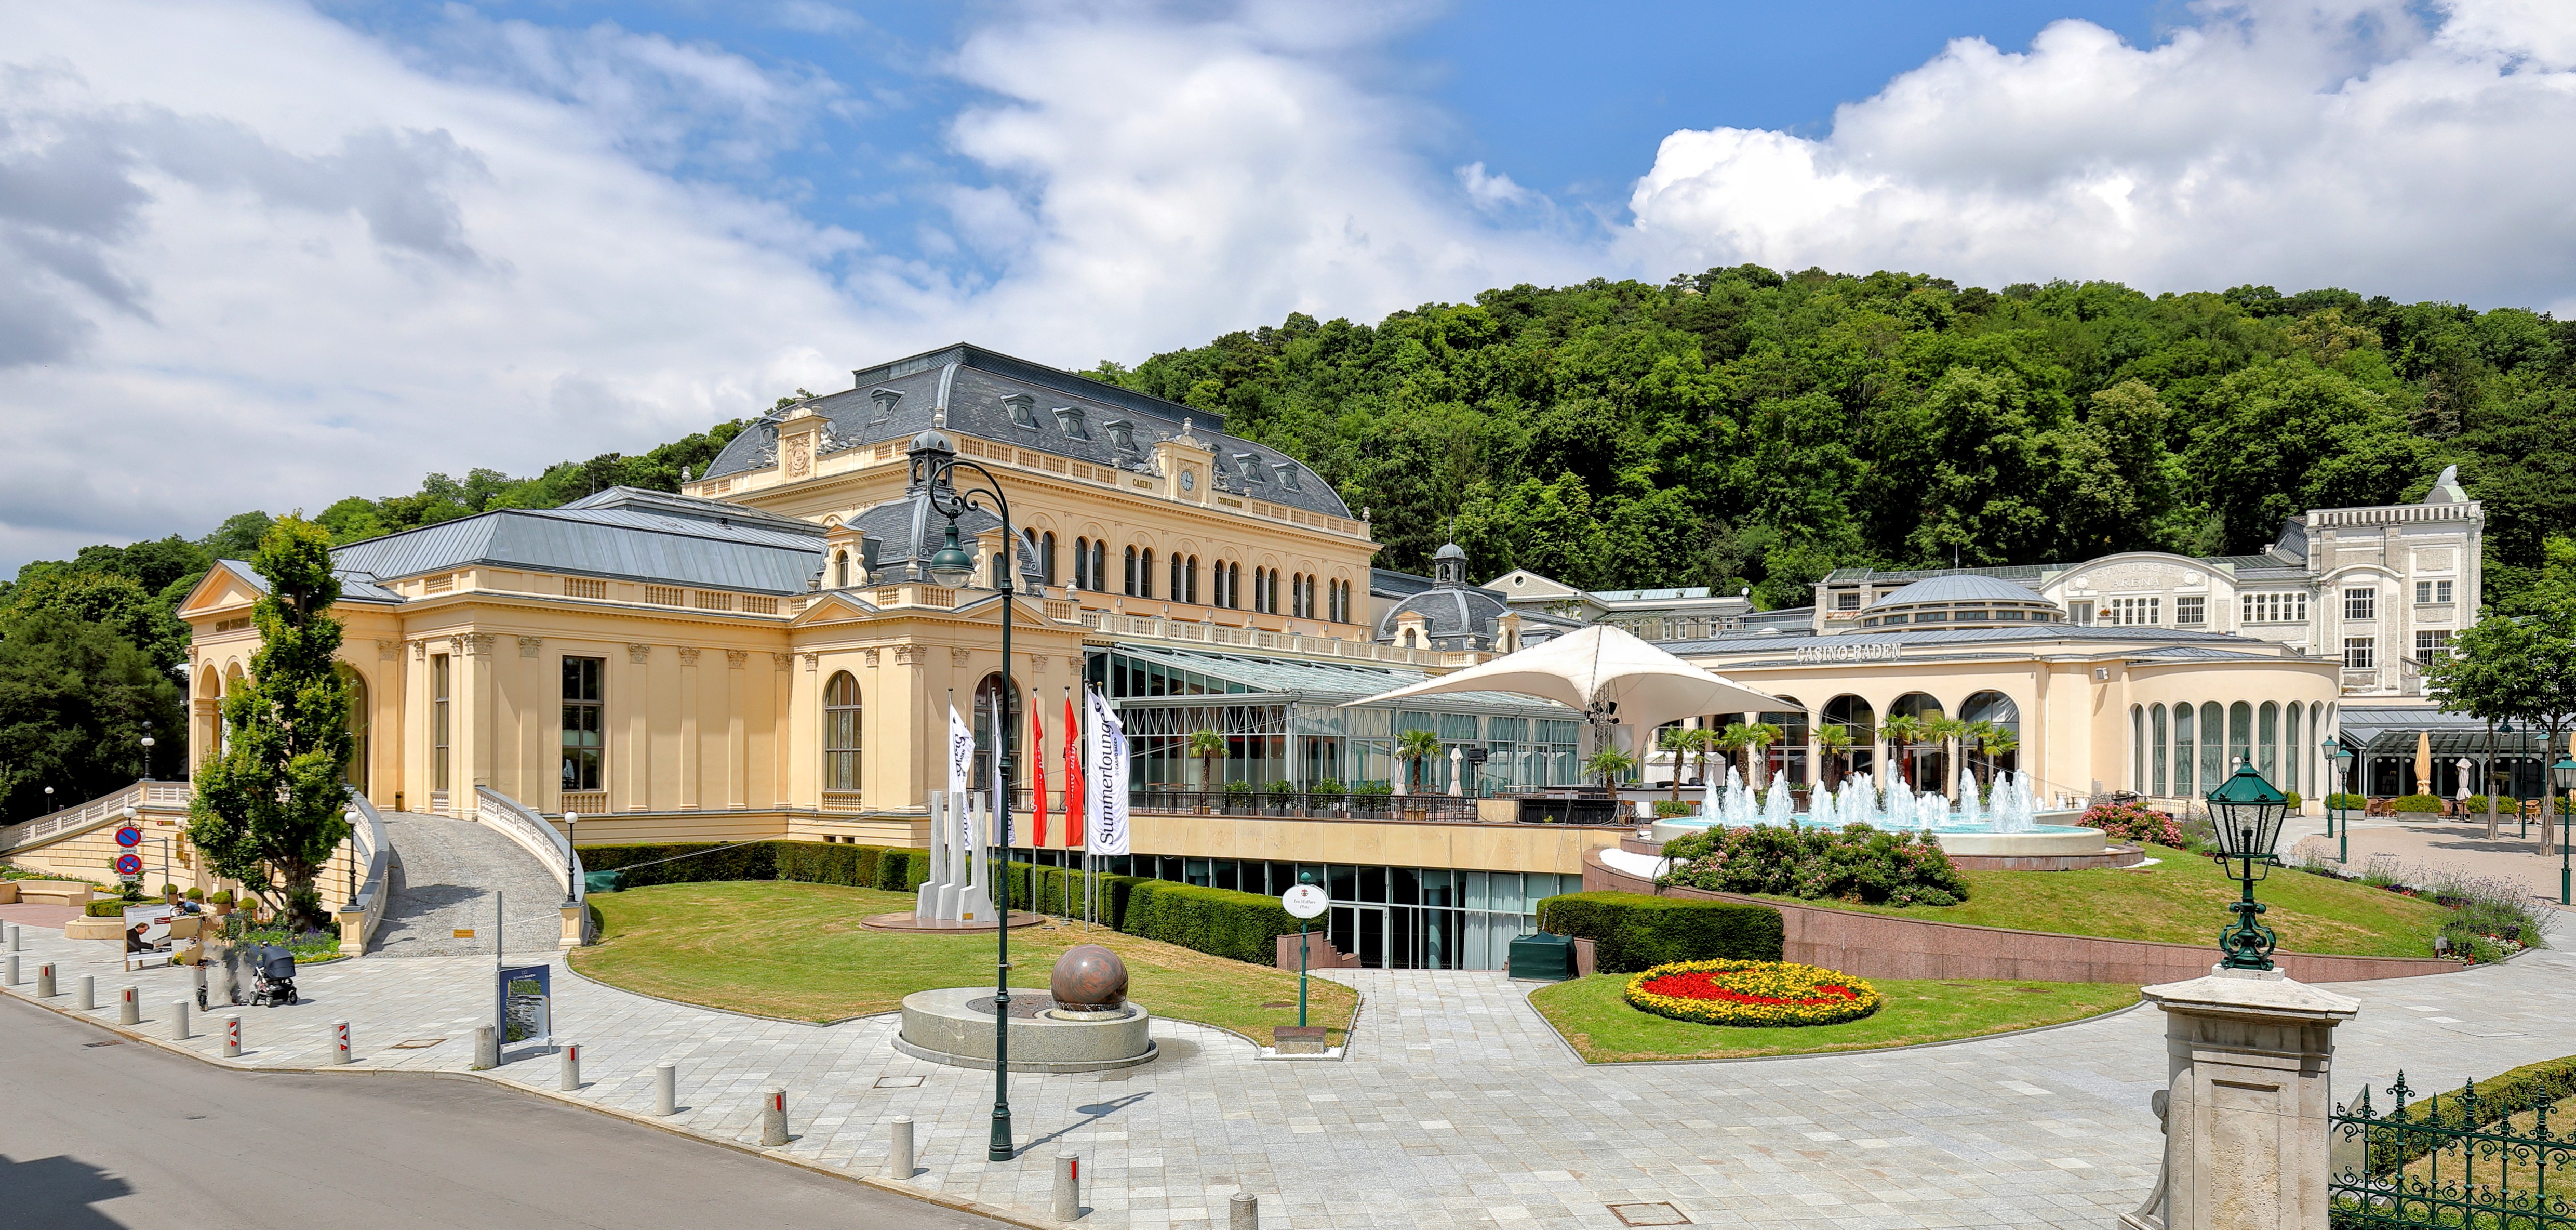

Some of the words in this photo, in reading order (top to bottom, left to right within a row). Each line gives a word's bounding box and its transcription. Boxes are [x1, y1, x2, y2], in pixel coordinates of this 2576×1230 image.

[1133, 479, 1152, 490] CASINO
[1218, 497, 1242, 508] CONGRESS
[2111, 578, 2160, 588] ARENA
[1796, 645, 1848, 662] CASINO
[1852, 643, 1901, 659] BADEN
[1099, 713, 1114, 845] Summerlounge
